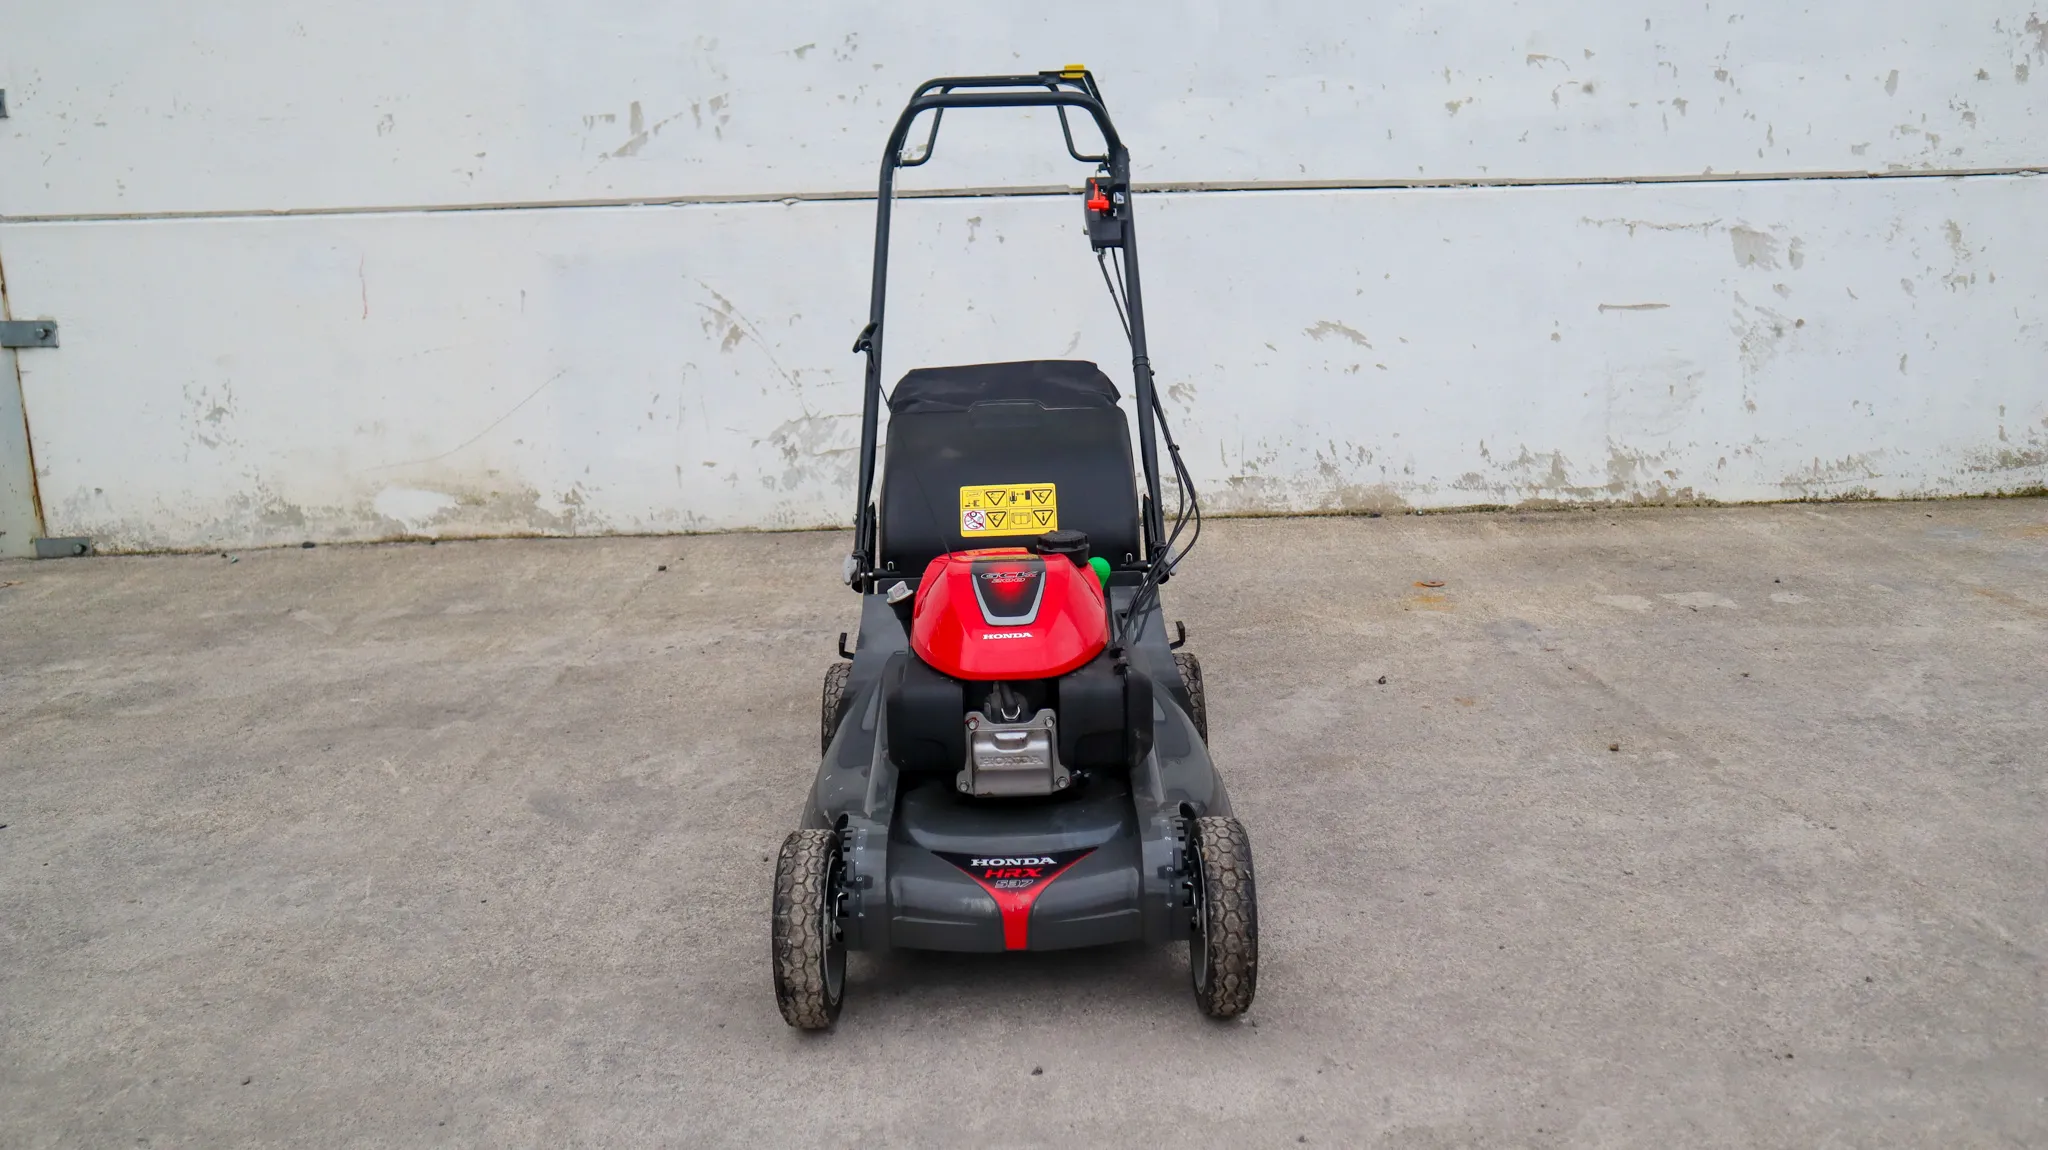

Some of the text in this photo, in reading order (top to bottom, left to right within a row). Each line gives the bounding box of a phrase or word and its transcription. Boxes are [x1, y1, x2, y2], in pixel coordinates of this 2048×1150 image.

[982, 632, 1033, 640] HONDA
[979, 755, 1044, 767] HONDA
[970, 856, 1057, 867] HONDA
[984, 867, 1044, 879] HRX
